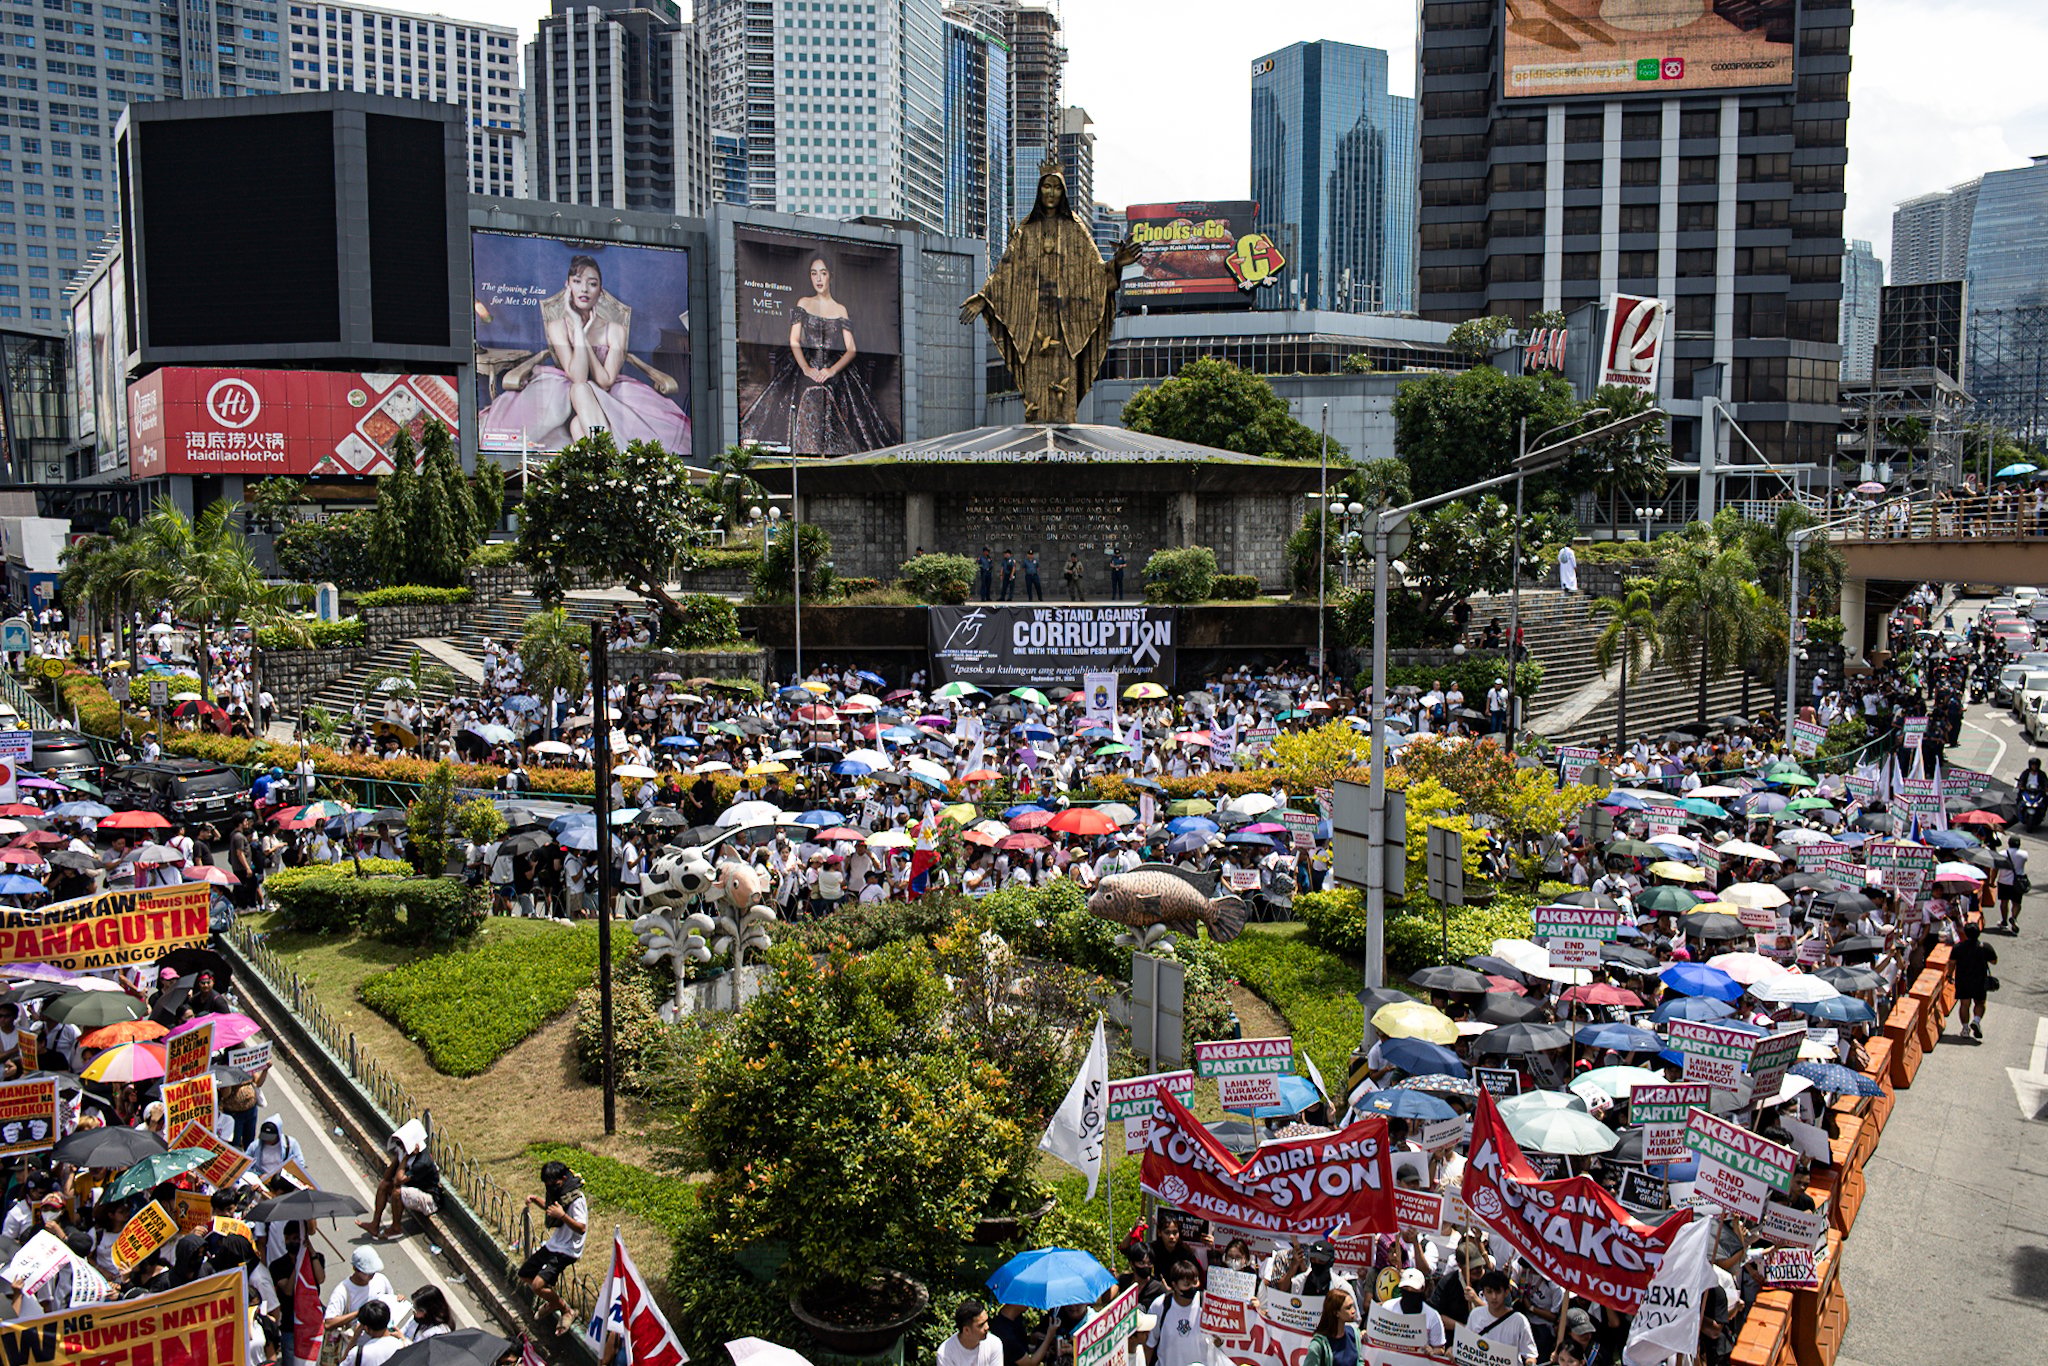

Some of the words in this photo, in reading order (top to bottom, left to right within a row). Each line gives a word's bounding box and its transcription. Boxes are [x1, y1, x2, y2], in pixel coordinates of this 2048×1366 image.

[1253, 59, 1274, 76] BDO
[1515, 66, 1630, 82] goldilocksdelivery.ph
[1132, 221, 1191, 243] Chooks
[1192, 226, 1201, 237] to
[1204, 219, 1225, 239] Go
[481, 283, 496, 291] The
[498, 284, 528, 295] glowing
[529, 286, 547, 295] Liza
[744, 279, 764, 288] Andrea
[490, 296, 503, 306] for
[505, 297, 520, 305] Met
[522, 297, 537, 306] 500
[763, 290, 773, 298] for
[753, 298, 783, 308] MET
[1525, 328, 1568, 372] H&M
[1605, 373, 1651, 385] ROBINSONS
[218, 388, 249, 417] Hi
[185, 431, 285, 450] 海底捞火锅
[896, 451, 962, 461] NATIONAL
[970, 451, 1020, 462] SHRINE
[1024, 451, 1042, 461] OF
[1047, 451, 1087, 462] MARY,
[1092, 451, 1138, 461] QUEEN
[1034, 609, 1052, 621] WE
[1055, 609, 1092, 621] STAND
[1097, 608, 1148, 621] AGAINST
[1060, 647, 1089, 655] TRILLION
[1038, 667, 1054, 676] ang
[1246, 728, 1276, 736] AKBAYAN
[1793, 729, 1825, 744] PARTYLIST
[1795, 722, 1827, 737] AKBAYAN
[1949, 771, 1990, 782] AKBAYAN
[1642, 815, 1685, 825] PARTYLIST
[1798, 847, 1843, 855] AKBAYAN
[1827, 861, 1865, 877] AKBAYAN
[1827, 871, 1866, 887] PARTYLIST
[139, 892, 153, 901] NG
[139, 896, 182, 911] BUWIS
[1538, 910, 1615, 926] AKBAYAN
[1537, 925, 1615, 939] PARTYLIST
[1564, 941, 1585, 950] END
[170, 1031, 199, 1049] KRISIS
[1672, 1024, 1756, 1049] AKBAYAN
[1757, 1032, 1802, 1056] AKBAYAN
[171, 1050, 182, 1059] SA
[183, 1036, 208, 1054] KLIMA
[1200, 1042, 1290, 1059] AKBAYAN
[1671, 1037, 1752, 1062] PARTYLIST
[170, 1047, 206, 1070] PINERA
[181, 1060, 198, 1073] MGA
[1201, 1057, 1290, 1074] PARTYLIST
[1689, 1057, 1718, 1068] LAHAT
[1721, 1063, 1734, 1071] NG
[1751, 1049, 1798, 1068] PARTYLIST
[1224, 1080, 1255, 1088] LAHAT
[1258, 1078, 1271, 1086] NG
[1686, 1071, 1736, 1086] MANAGOT!
[166, 1078, 212, 1103] NAKAW
[1224, 1092, 1276, 1103] MANAGOT!
[1634, 1088, 1707, 1103] AKBAYAN
[170, 1104, 179, 1114] SA
[179, 1093, 212, 1112] DPWH
[170, 1105, 212, 1127] PROJECTS
[1650, 1130, 1675, 1138] LAHAT
[1321, 1138, 1378, 1163] ANG
[1690, 1115, 1793, 1170] AKBAYAN
[1687, 1131, 1788, 1187] PARTYLIST
[1634, 1177, 1647, 1187] This
[1717, 1169, 1744, 1188] END
[1635, 1187, 1650, 1197] your
[1699, 1171, 1760, 1204] CORRUPTION
[1639, 1193, 1662, 1205] GHOST
[1713, 1187, 1741, 1206] NOW!
[145, 1206, 167, 1230] KRISIS
[1189, 1192, 1281, 1231] AKBAYAN
[1287, 1212, 1351, 1232] YOUTH
[1772, 1211, 1797, 1222] MILLION
[138, 1212, 146, 1224] SA
[144, 1222, 164, 1243] KLIMA
[1771, 1216, 1791, 1227] TAKES
[130, 1218, 156, 1250] PINERA
[1610, 1220, 1665, 1248] MGA
[1787, 1228, 1812, 1238] AWAY!
[128, 1235, 143, 1251] MGA
[1501, 1216, 1580, 1284] AKBAYAN
[63, 1316, 156, 1356] BUWIS
[162, 1296, 235, 1329] NATIN
[64, 1314, 94, 1334] NG
[1078, 1291, 1137, 1353] AKBAYAN
[1202, 1313, 1239, 1329] BAYAN
[1378, 1317, 1410, 1329] NORMALIZE
[1374, 1326, 1415, 1339] ACCOUNTABLE
[1392, 1325, 1422, 1335] OFFICIALS
[1079, 1314, 1137, 1366] PARTYLIST
[1457, 1340, 1487, 1359] KADIRI
[1489, 1354, 1512, 1365] ANG
